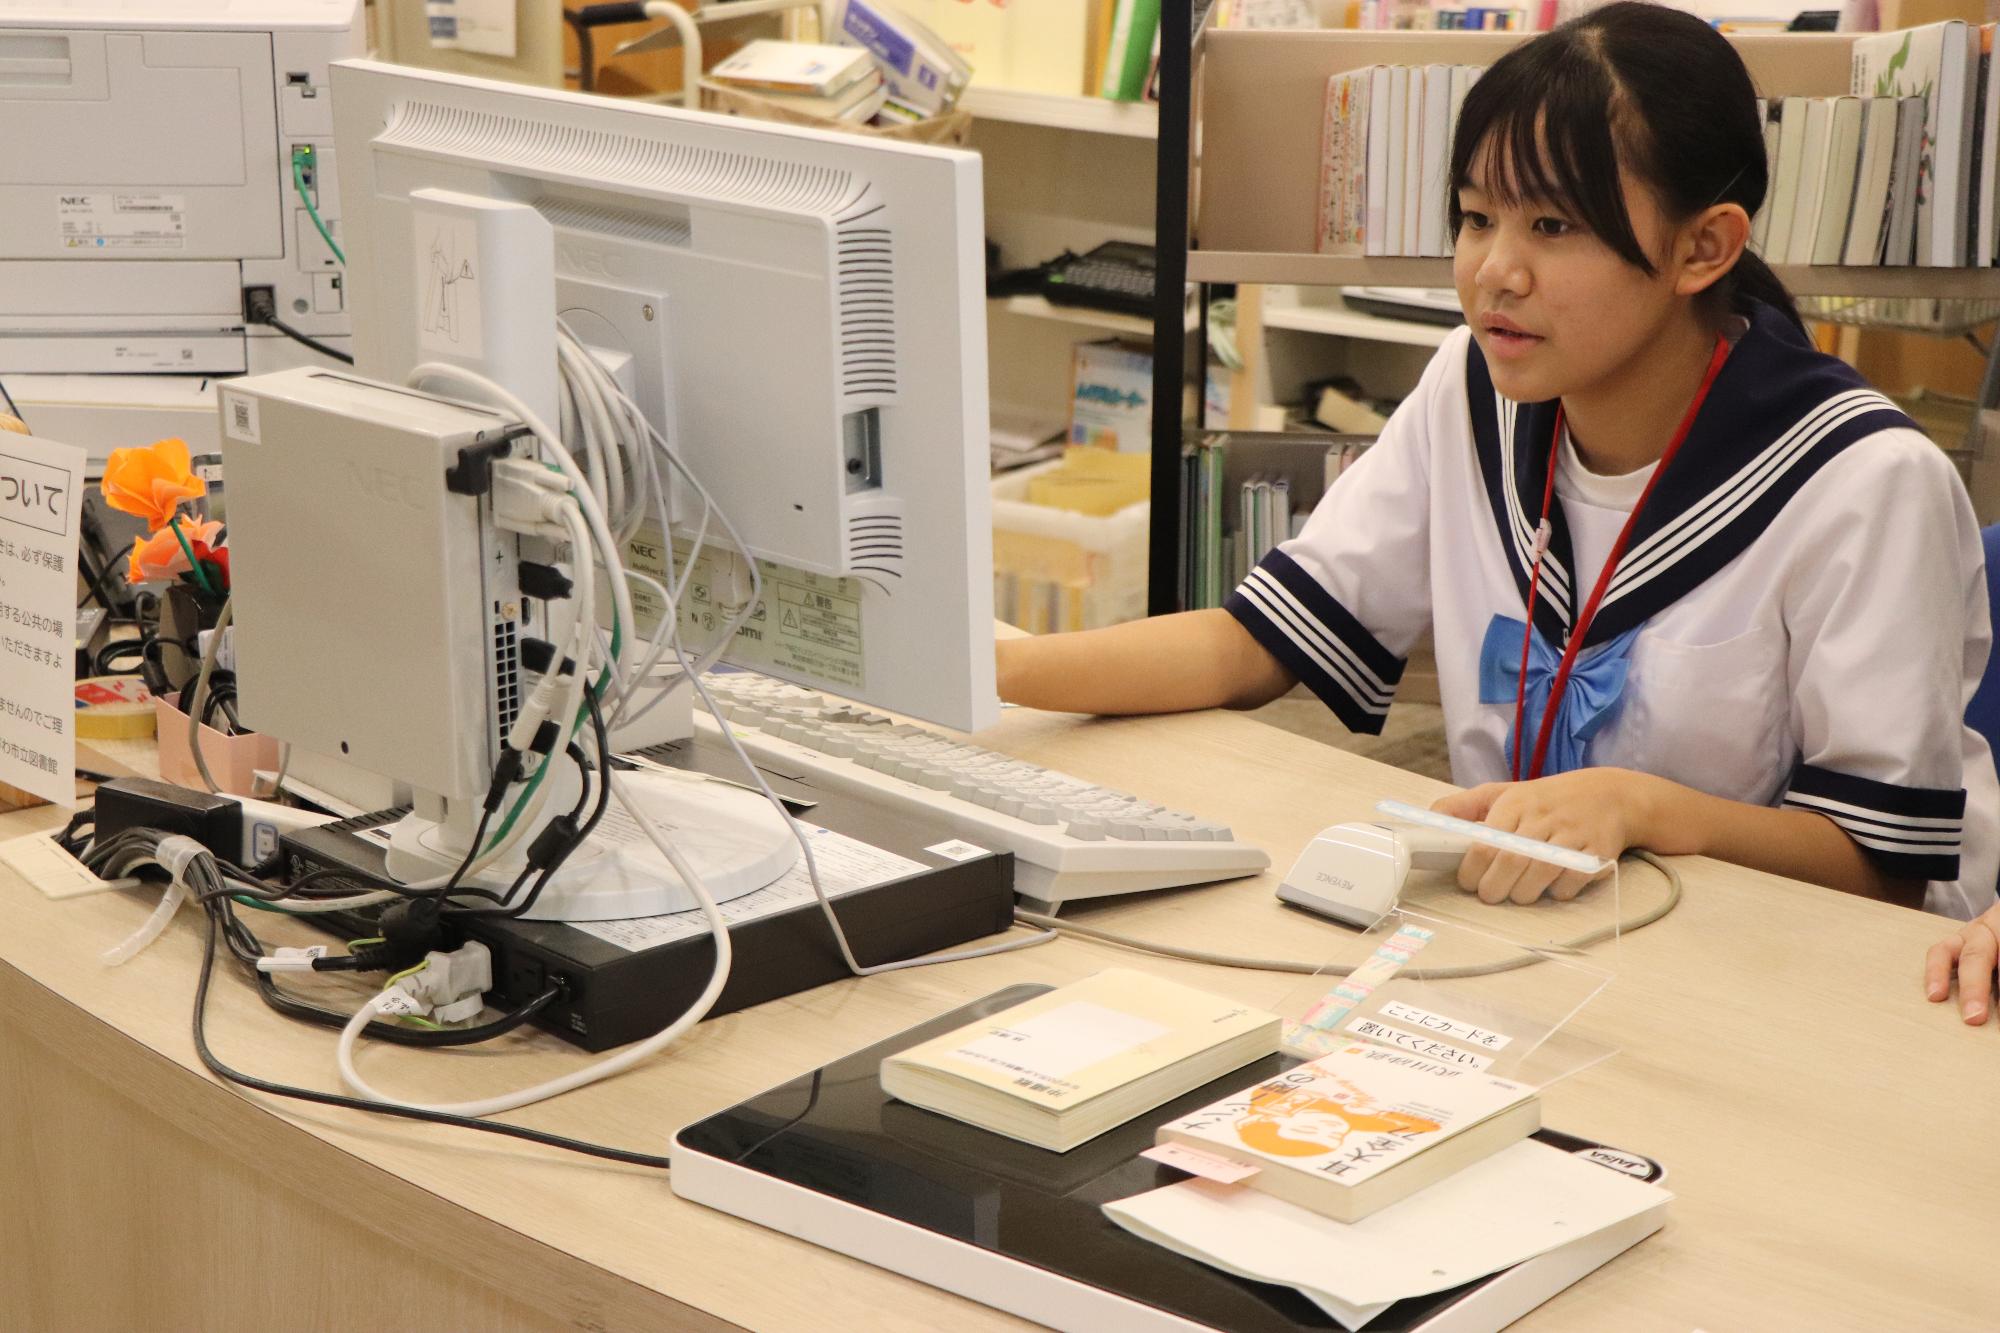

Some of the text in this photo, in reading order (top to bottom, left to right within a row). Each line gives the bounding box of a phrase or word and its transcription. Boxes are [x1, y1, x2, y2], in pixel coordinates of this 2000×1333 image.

[60, 196, 91, 206] NEC
[0, 475, 64, 516] ついて
[630, 543, 657, 560] NEC
[0, 736, 58, 776] わ市立図書館
[1315, 871, 1355, 891] KEYENCE
[1357, 1020, 1479, 1069] 置いてください。
[1388, 1005, 1498, 1046] ここにカードを
